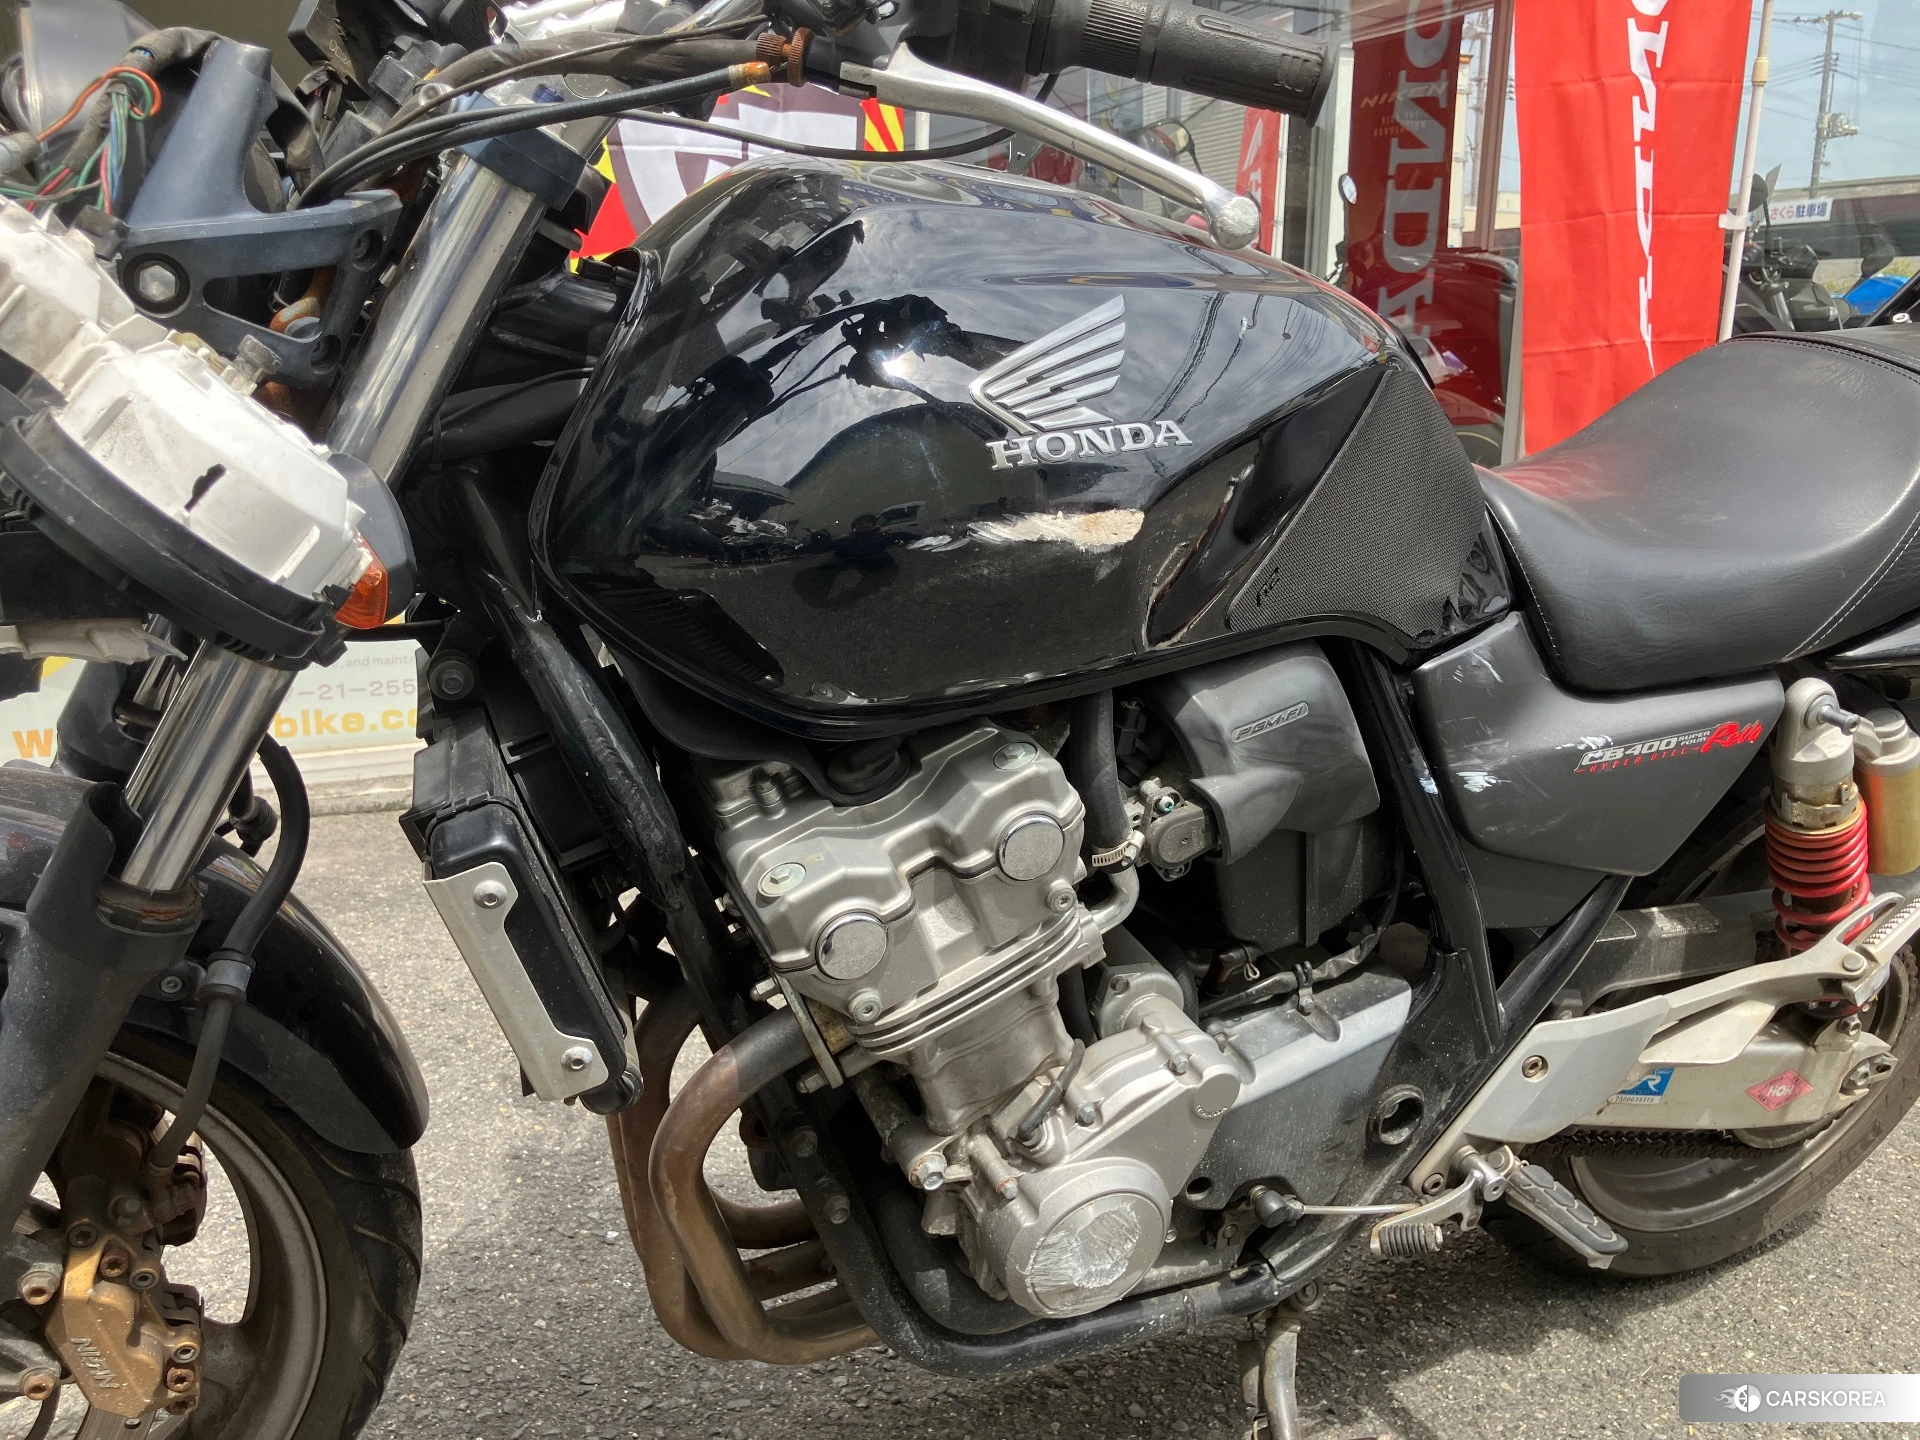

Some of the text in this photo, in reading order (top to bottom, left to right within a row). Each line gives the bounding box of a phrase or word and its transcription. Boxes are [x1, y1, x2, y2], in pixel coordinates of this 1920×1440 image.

[1627, 0, 1669, 378] NDA
[1769, 201, 1828, 220] さくら駐車場
[986, 420, 1193, 472] HONDA
[346, 655, 370, 668] and
[1582, 730, 1711, 766] CB400 SUPER
[1681, 736, 1708, 746] FOUR
[1590, 757, 1642, 773] HYPER
